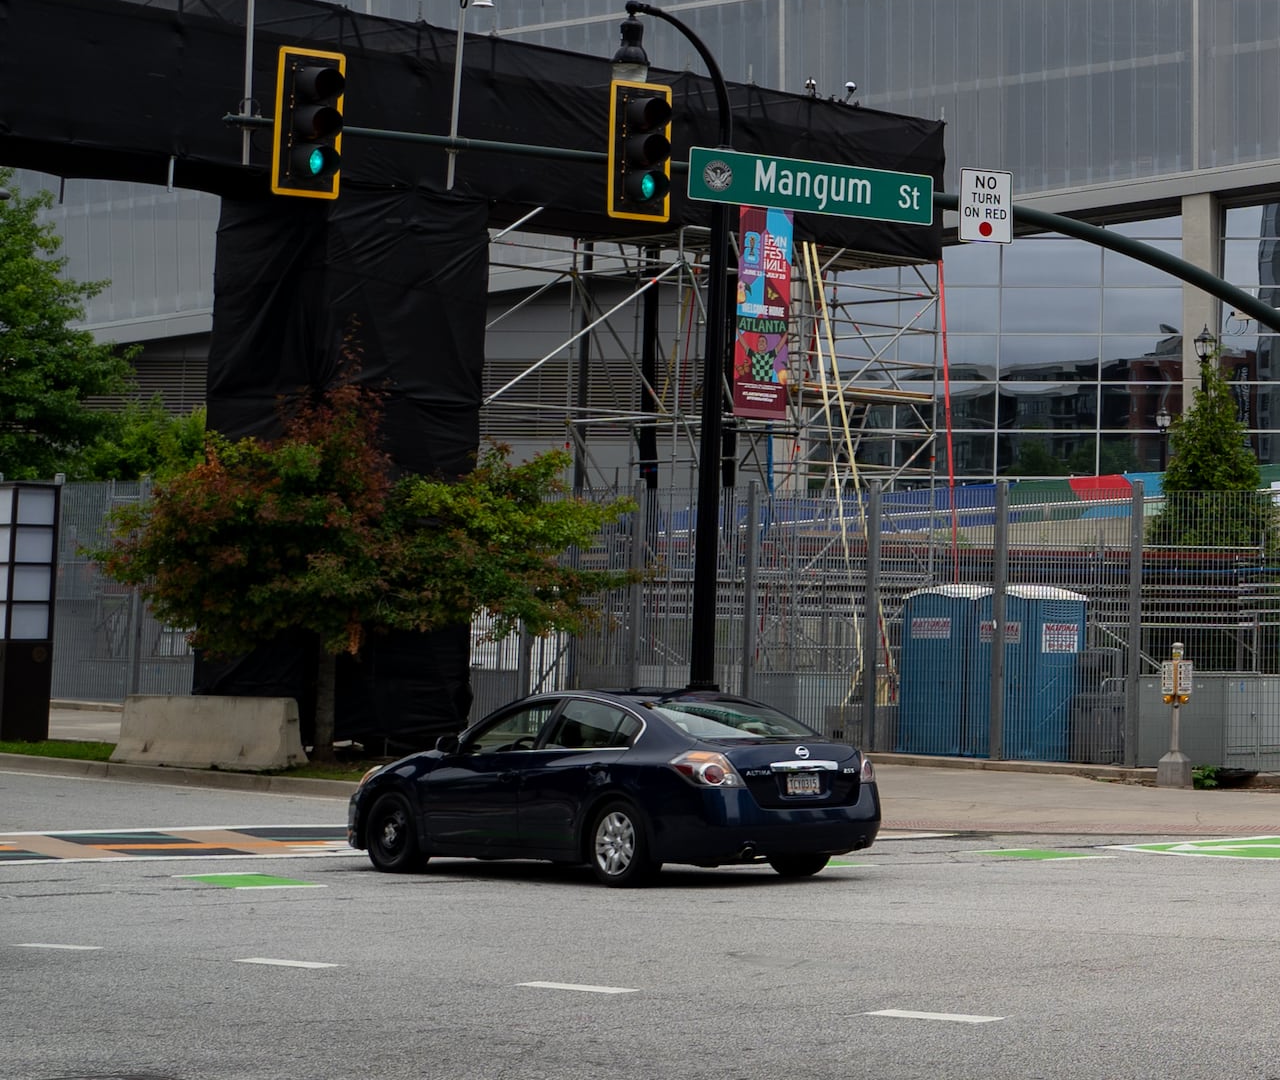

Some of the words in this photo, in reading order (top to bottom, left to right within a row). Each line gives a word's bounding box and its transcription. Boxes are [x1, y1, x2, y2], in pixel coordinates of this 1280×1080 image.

[755, 160, 871, 210] Mangum
[898, 185, 920, 210] St
[975, 175, 997, 189] NO
[972, 192, 1001, 205] TURN
[965, 206, 979, 217] ON
[985, 208, 1007, 219] RED
[768, 235, 787, 248] FAN
[764, 246, 787, 260] FEST
[741, 303, 769, 316] WELCOME
[768, 306, 785, 317] HOME
[739, 317, 787, 333] ATLANTA
